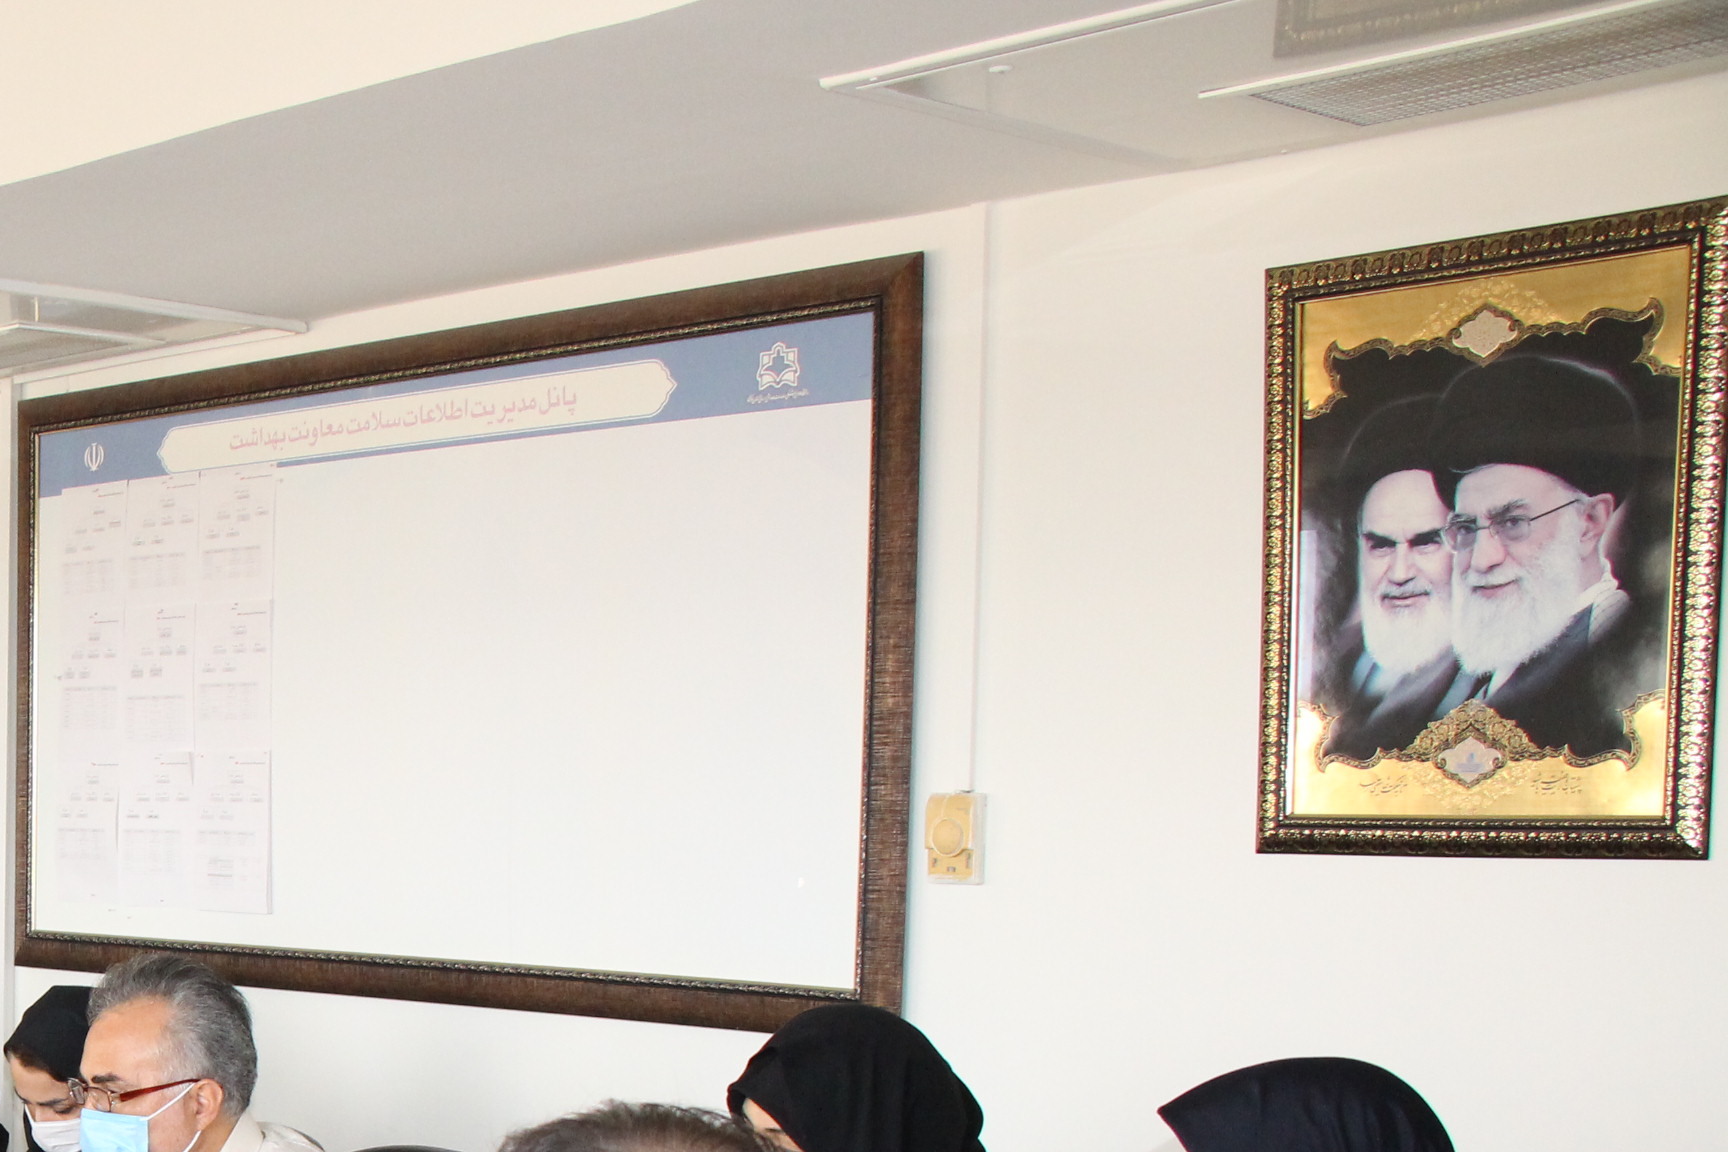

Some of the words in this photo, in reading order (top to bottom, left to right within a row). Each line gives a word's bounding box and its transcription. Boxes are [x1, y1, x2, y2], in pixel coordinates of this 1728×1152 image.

[402, 398, 469, 428] اطلاعات
[471, 397, 537, 426] مدیریت
[538, 385, 577, 416] پانل
[288, 418, 344, 446] معاونت
[346, 411, 402, 435] سلامت
[229, 426, 286, 451] بهداشت
